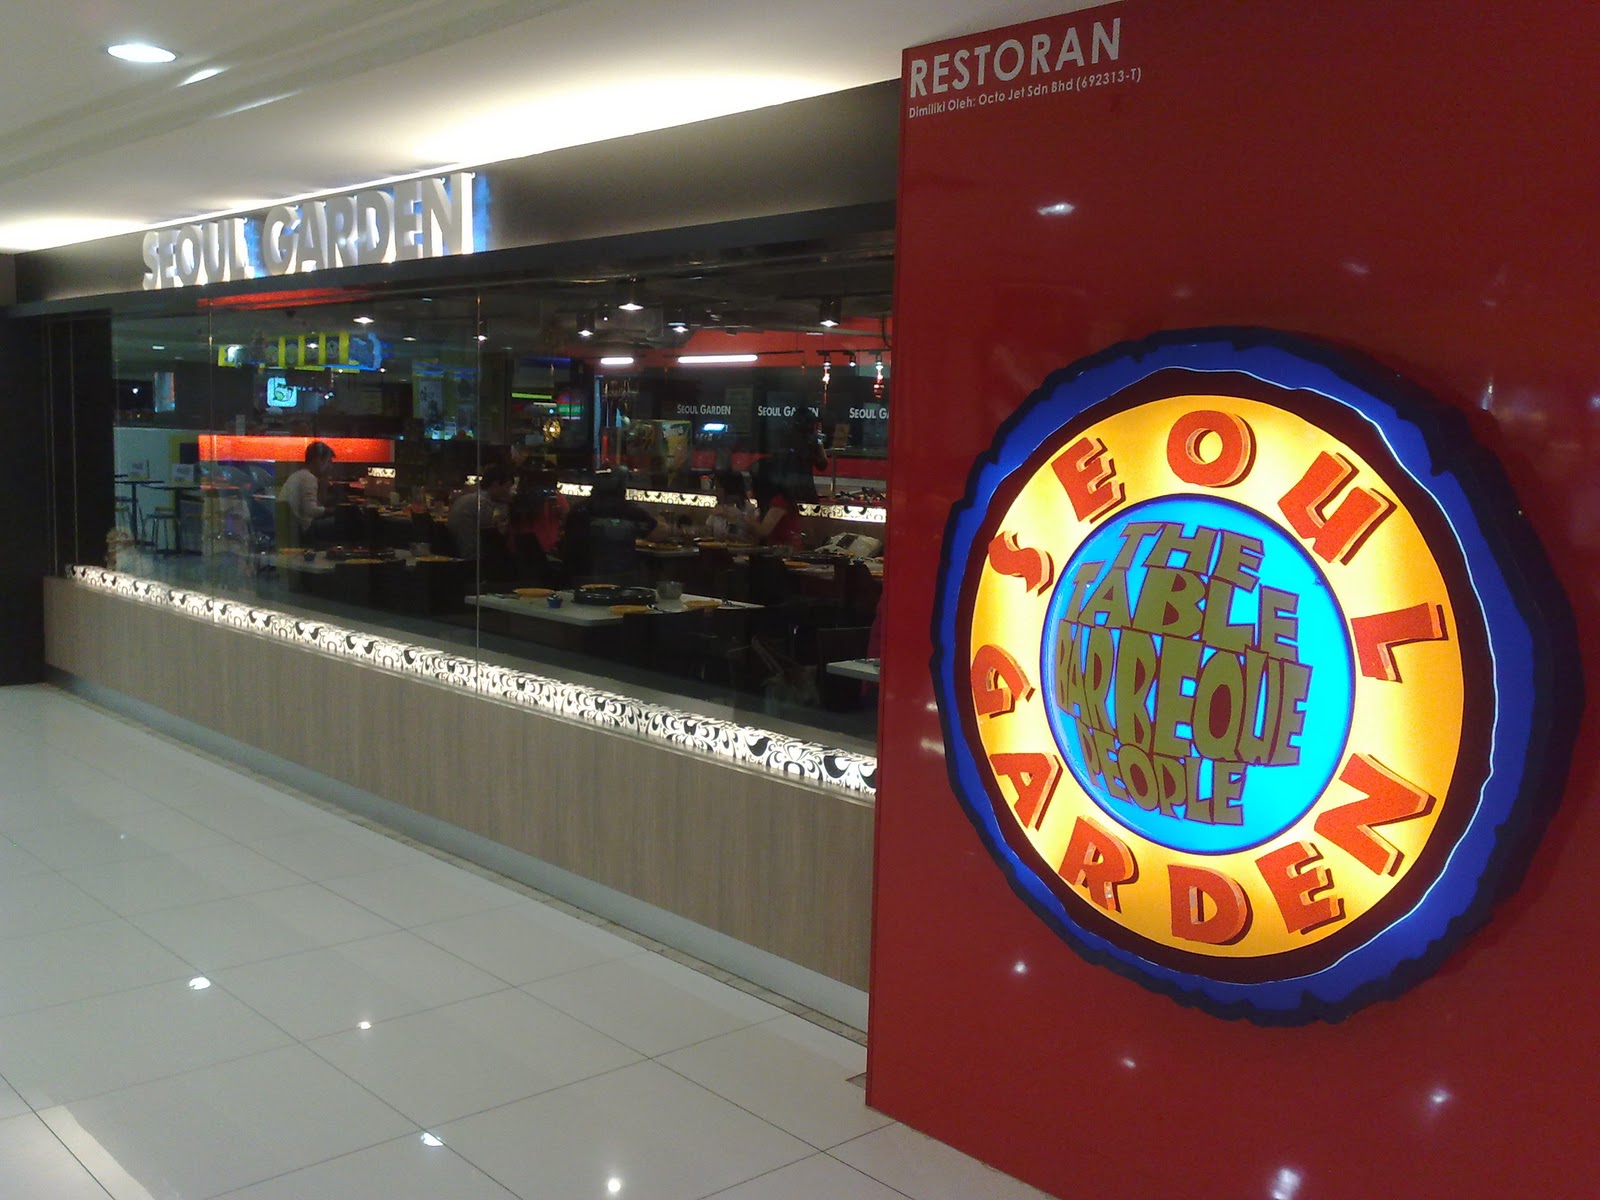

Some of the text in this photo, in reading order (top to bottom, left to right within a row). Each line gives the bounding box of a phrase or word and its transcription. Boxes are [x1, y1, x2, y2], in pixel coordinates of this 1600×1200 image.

[909, 17, 1121, 98] RESTORAN
[909, 67, 1142, 118] Dimiliki Oleh: Octo Jet Sdn Bhd (692313-T)
[142, 171, 475, 290] SEOUL GARDEN
[677, 404, 731, 415] SEOUL GARDEN
[757, 405, 782, 417] SEOUL
[849, 407, 877, 419] SEOUL
[987, 409, 1449, 684] SEOUL
[1112, 521, 1265, 593] THE
[1064, 560, 1300, 663] TABLE
[1054, 618, 1314, 768] BARBEQUE
[970, 644, 1437, 945] GARDEN
[1075, 718, 1248, 826] PEOPLE
